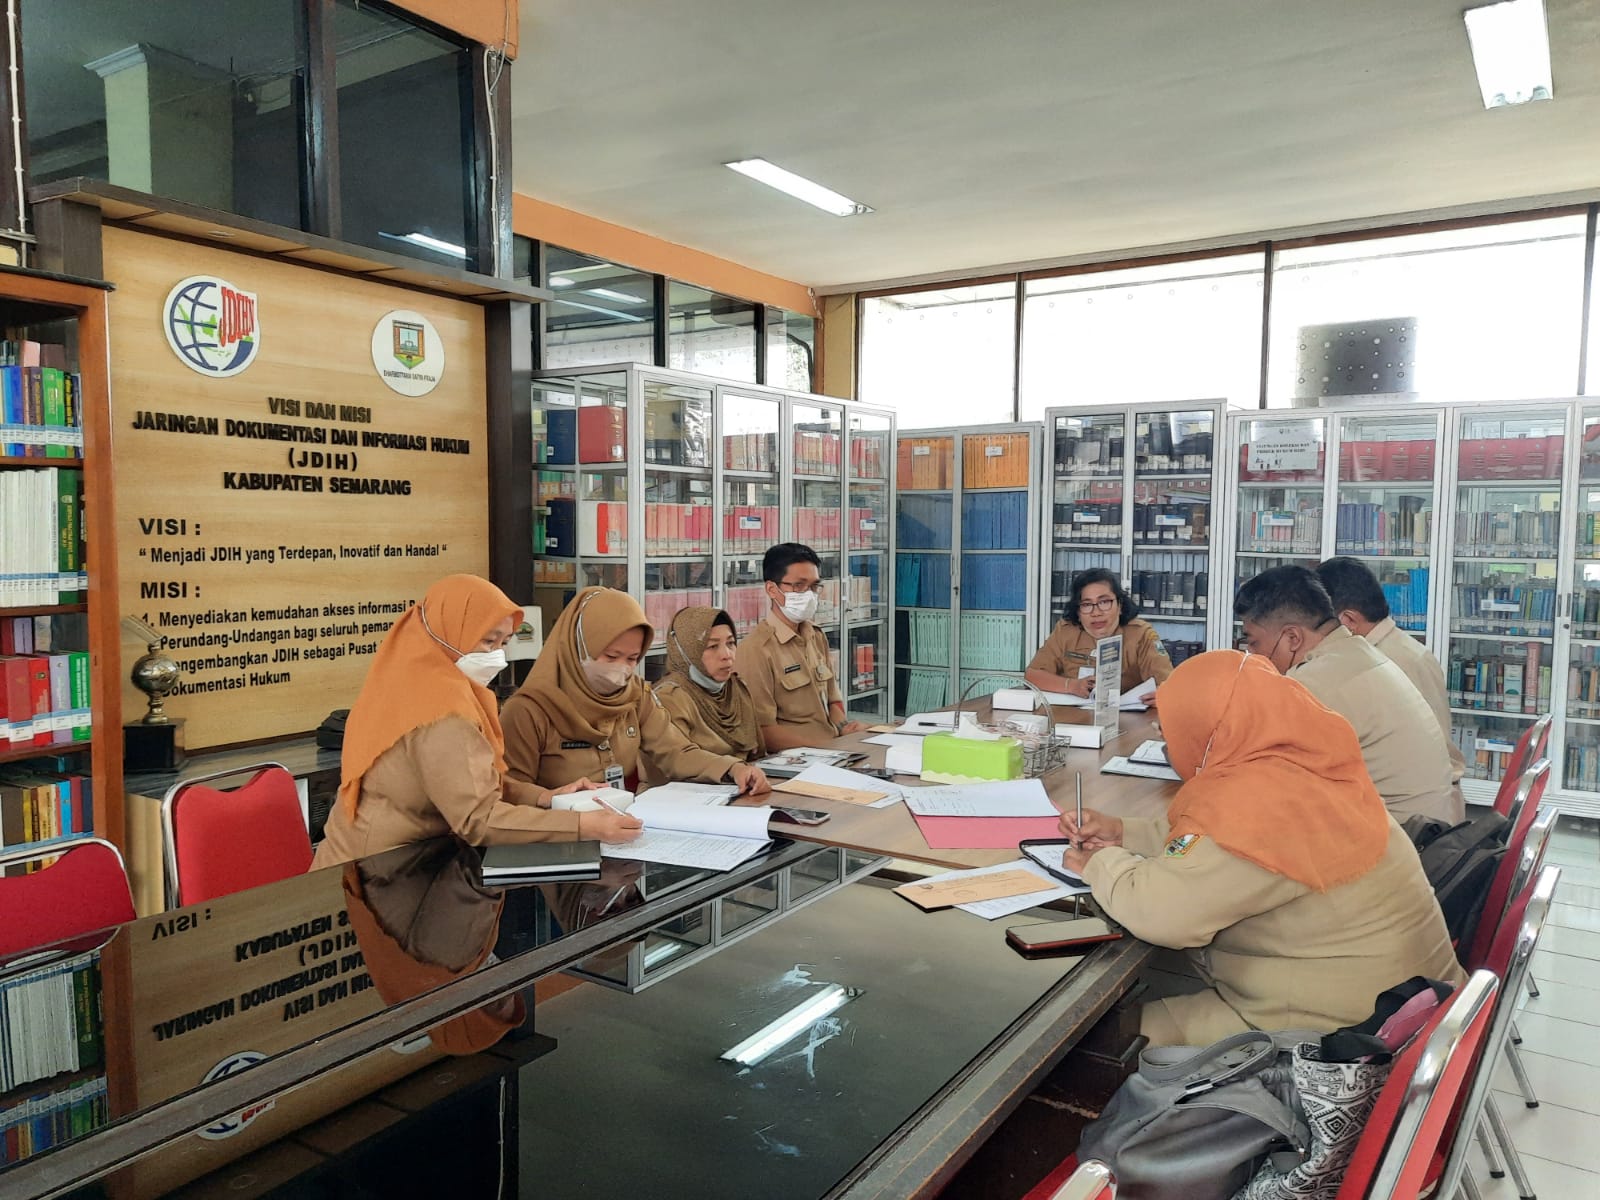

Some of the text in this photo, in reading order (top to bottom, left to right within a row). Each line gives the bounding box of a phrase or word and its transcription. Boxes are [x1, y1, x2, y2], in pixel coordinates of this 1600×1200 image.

[219, 286, 254, 347] JDIHN
[268, 397, 371, 423] VISI DAN MISI
[132, 411, 470, 454] JARINGAN DOKUMENTASI DAN INFORMASI HUKUM
[288, 447, 358, 471] (JDIH)
[224, 472, 412, 496] KABUPATEN SEMARANG
[138, 518, 187, 536] VISI
[151, 547, 206, 566] Menjadi
[210, 547, 242, 562] JDIH
[245, 549, 275, 564] yang
[278, 545, 337, 563] Terdepan,
[340, 545, 381, 558] Inovatif
[384, 545, 402, 557] dan
[405, 544, 439, 557] Handal
[140, 582, 187, 599] MISI
[159, 609, 247, 629] Menyediakan
[251, 604, 319, 621] kemudahan
[322, 603, 355, 617] akses
[358, 600, 407, 615] informasi
[160, 629, 290, 650] Perundang-Undangan
[320, 622, 359, 638] seluruh
[272, 647, 300, 663] JDIH
[303, 643, 345, 660] sebagai
[348, 640, 377, 655] Pusat
[250, 671, 291, 687] Hukum
